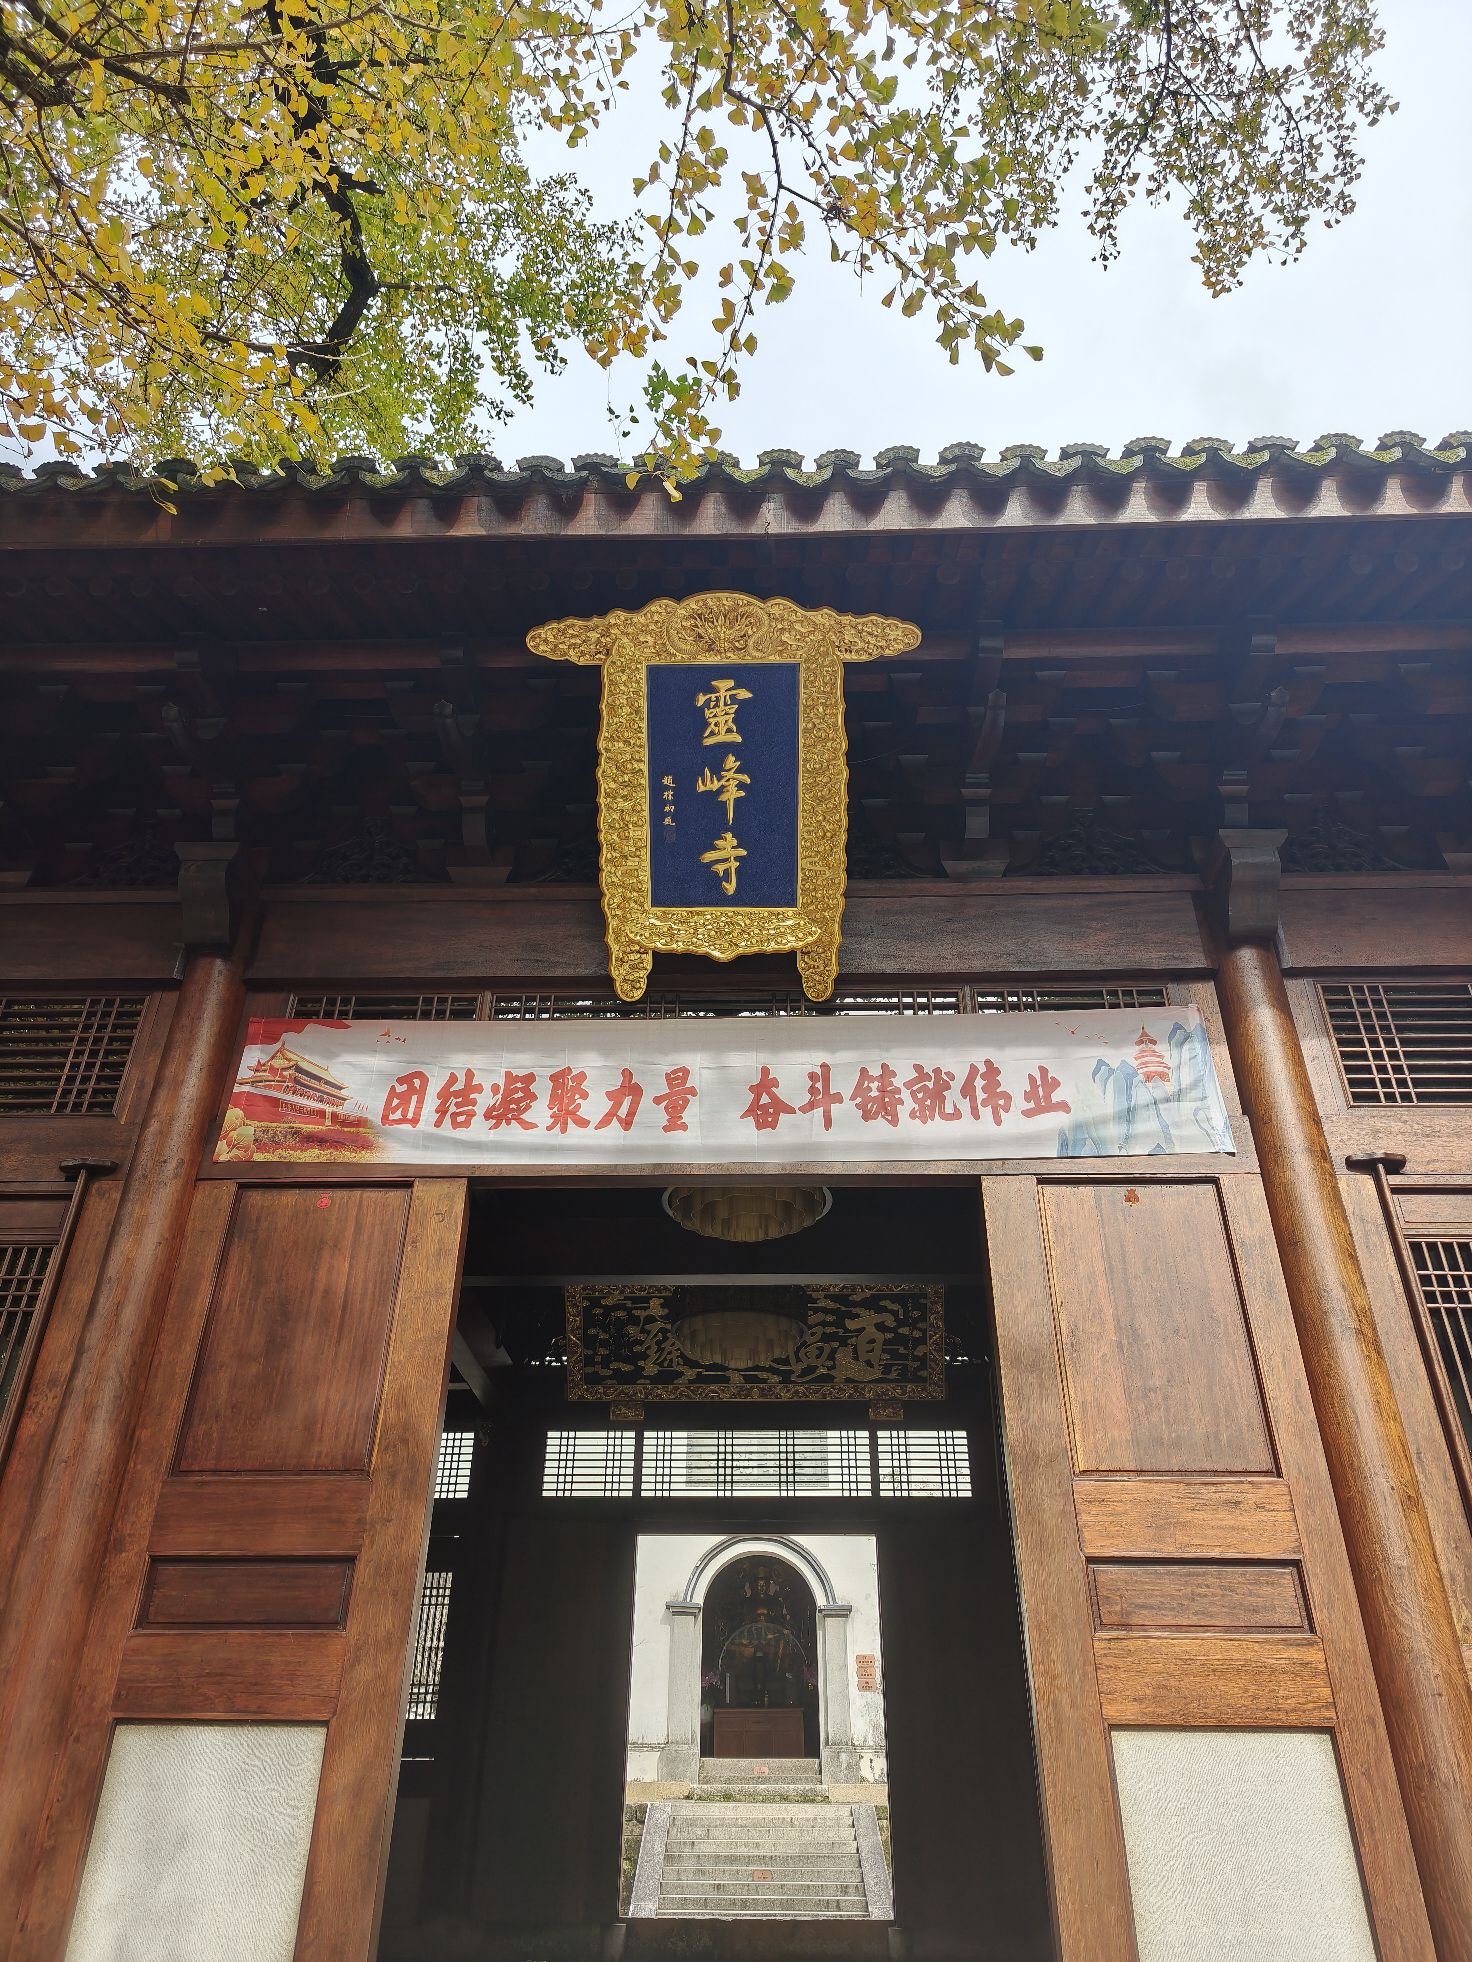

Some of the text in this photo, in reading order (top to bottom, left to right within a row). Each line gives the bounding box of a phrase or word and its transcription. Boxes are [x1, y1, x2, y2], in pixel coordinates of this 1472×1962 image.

[696, 679, 753, 895] 靈峰寺
[380, 1058, 1072, 1135] 团结凝聚力量 奋斗铸就伟业
